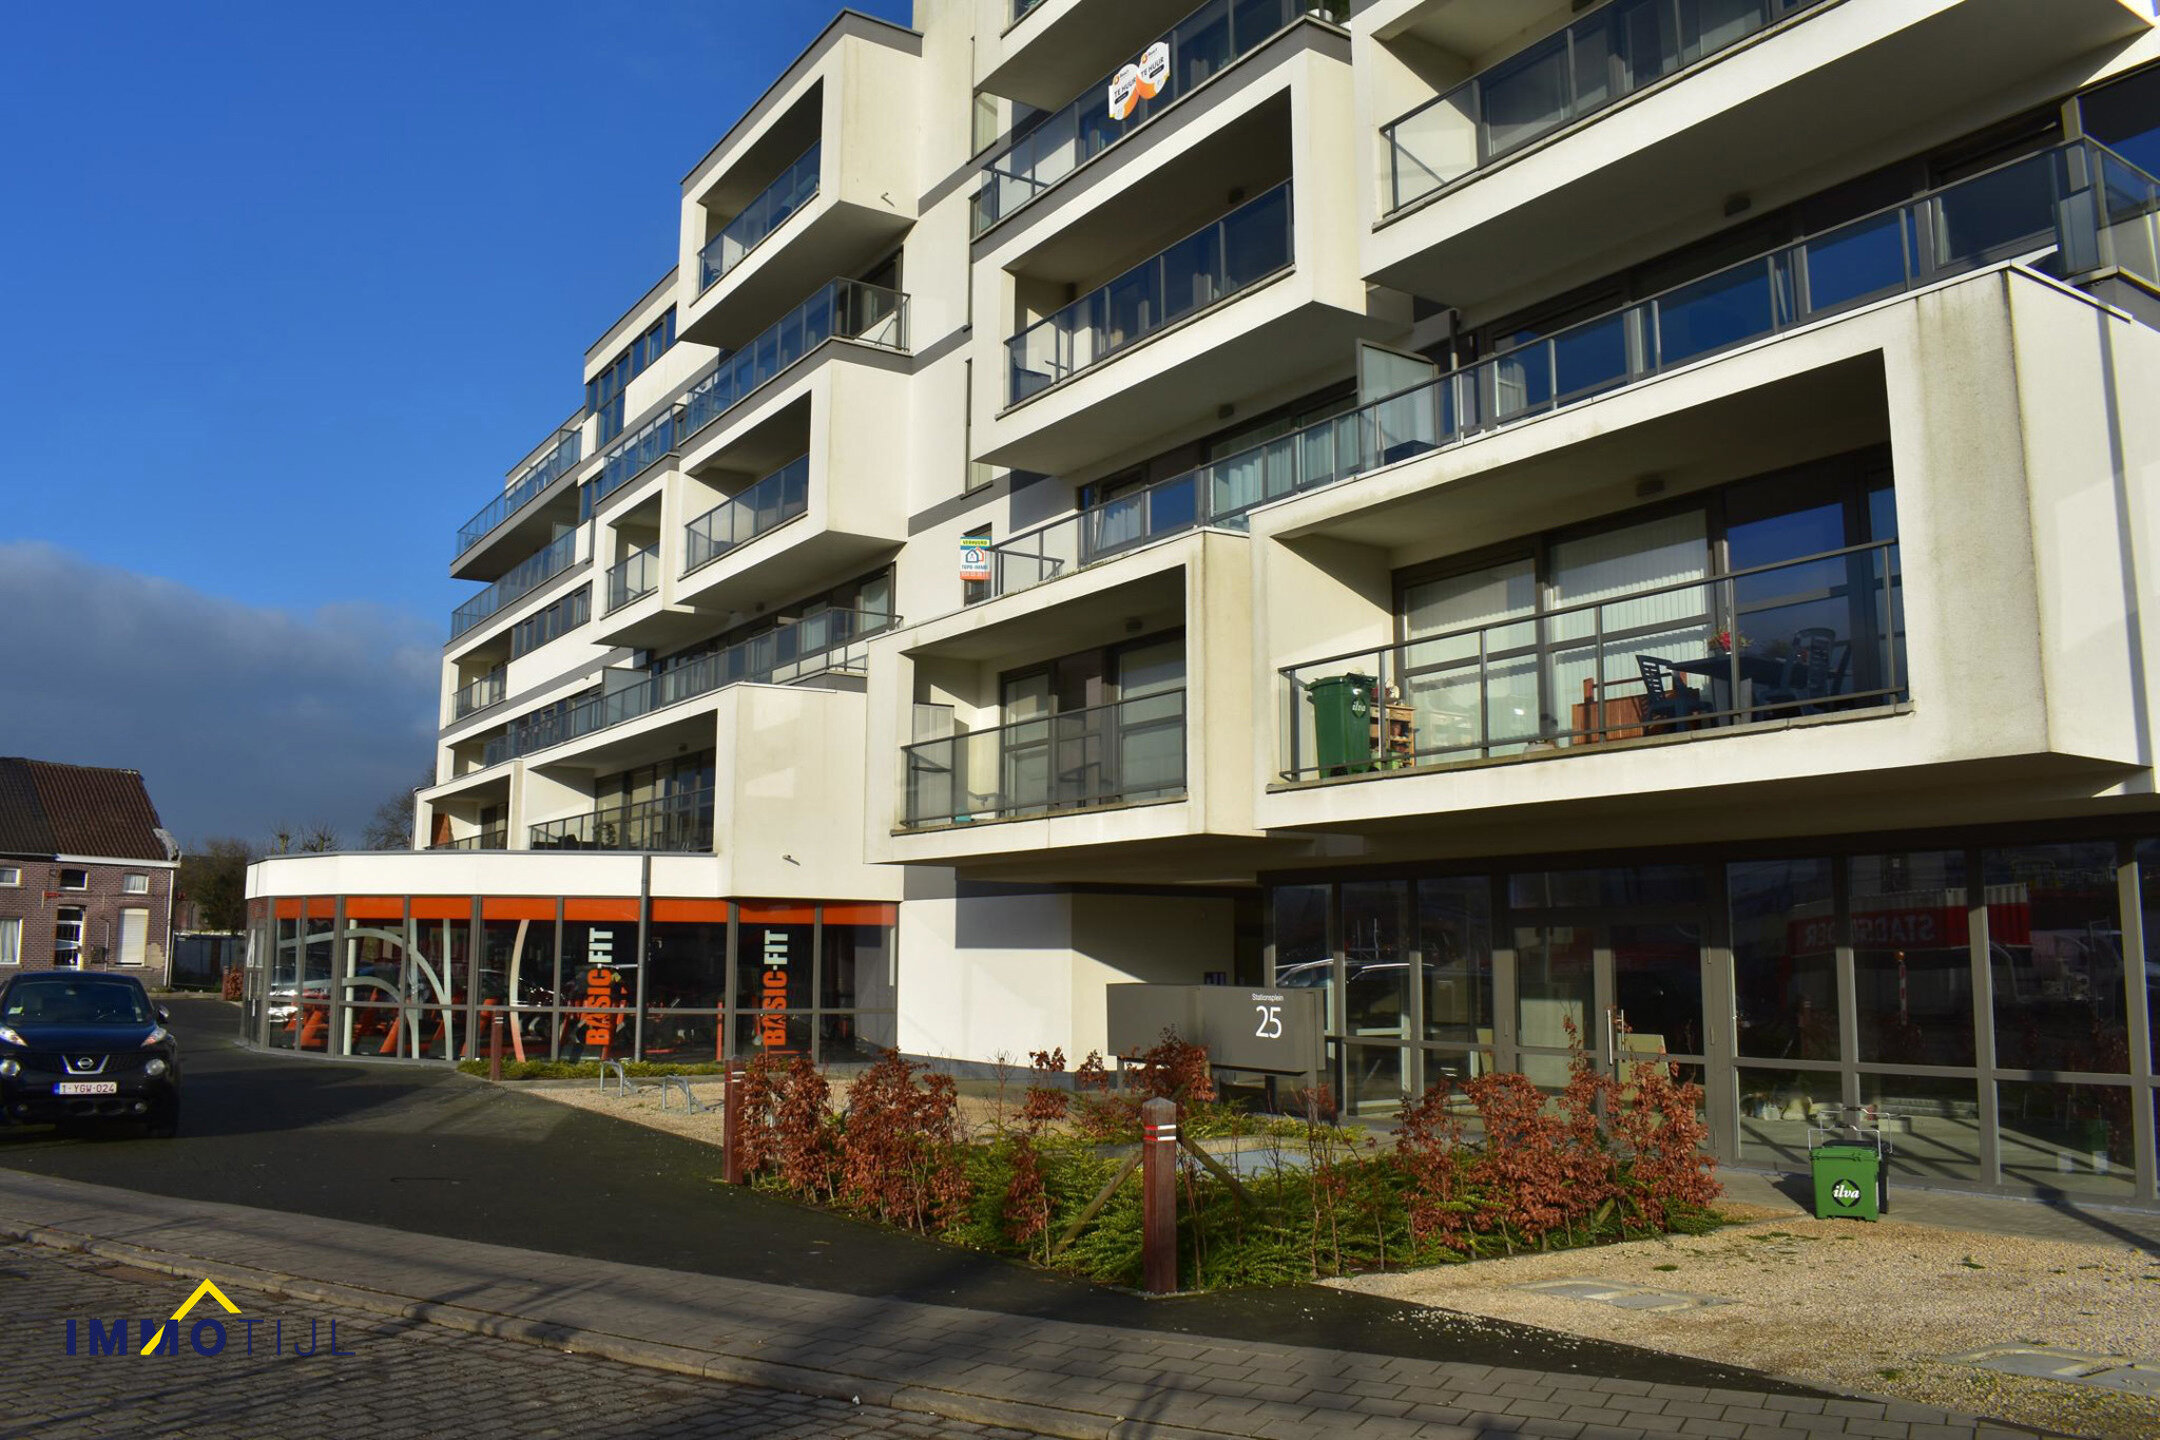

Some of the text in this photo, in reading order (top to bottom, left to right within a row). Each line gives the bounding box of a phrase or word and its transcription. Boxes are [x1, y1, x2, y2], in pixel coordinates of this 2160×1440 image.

[1149, 57, 1164, 72] HUUR
[586, 927, 613, 1045] BASIC-FIT
[763, 930, 788, 1045] BASIC-FIT
[1252, 993, 1284, 1002] Stationsplein
[1256, 1005, 1282, 1038] 25
[1833, 1185, 1860, 1199] ilva
